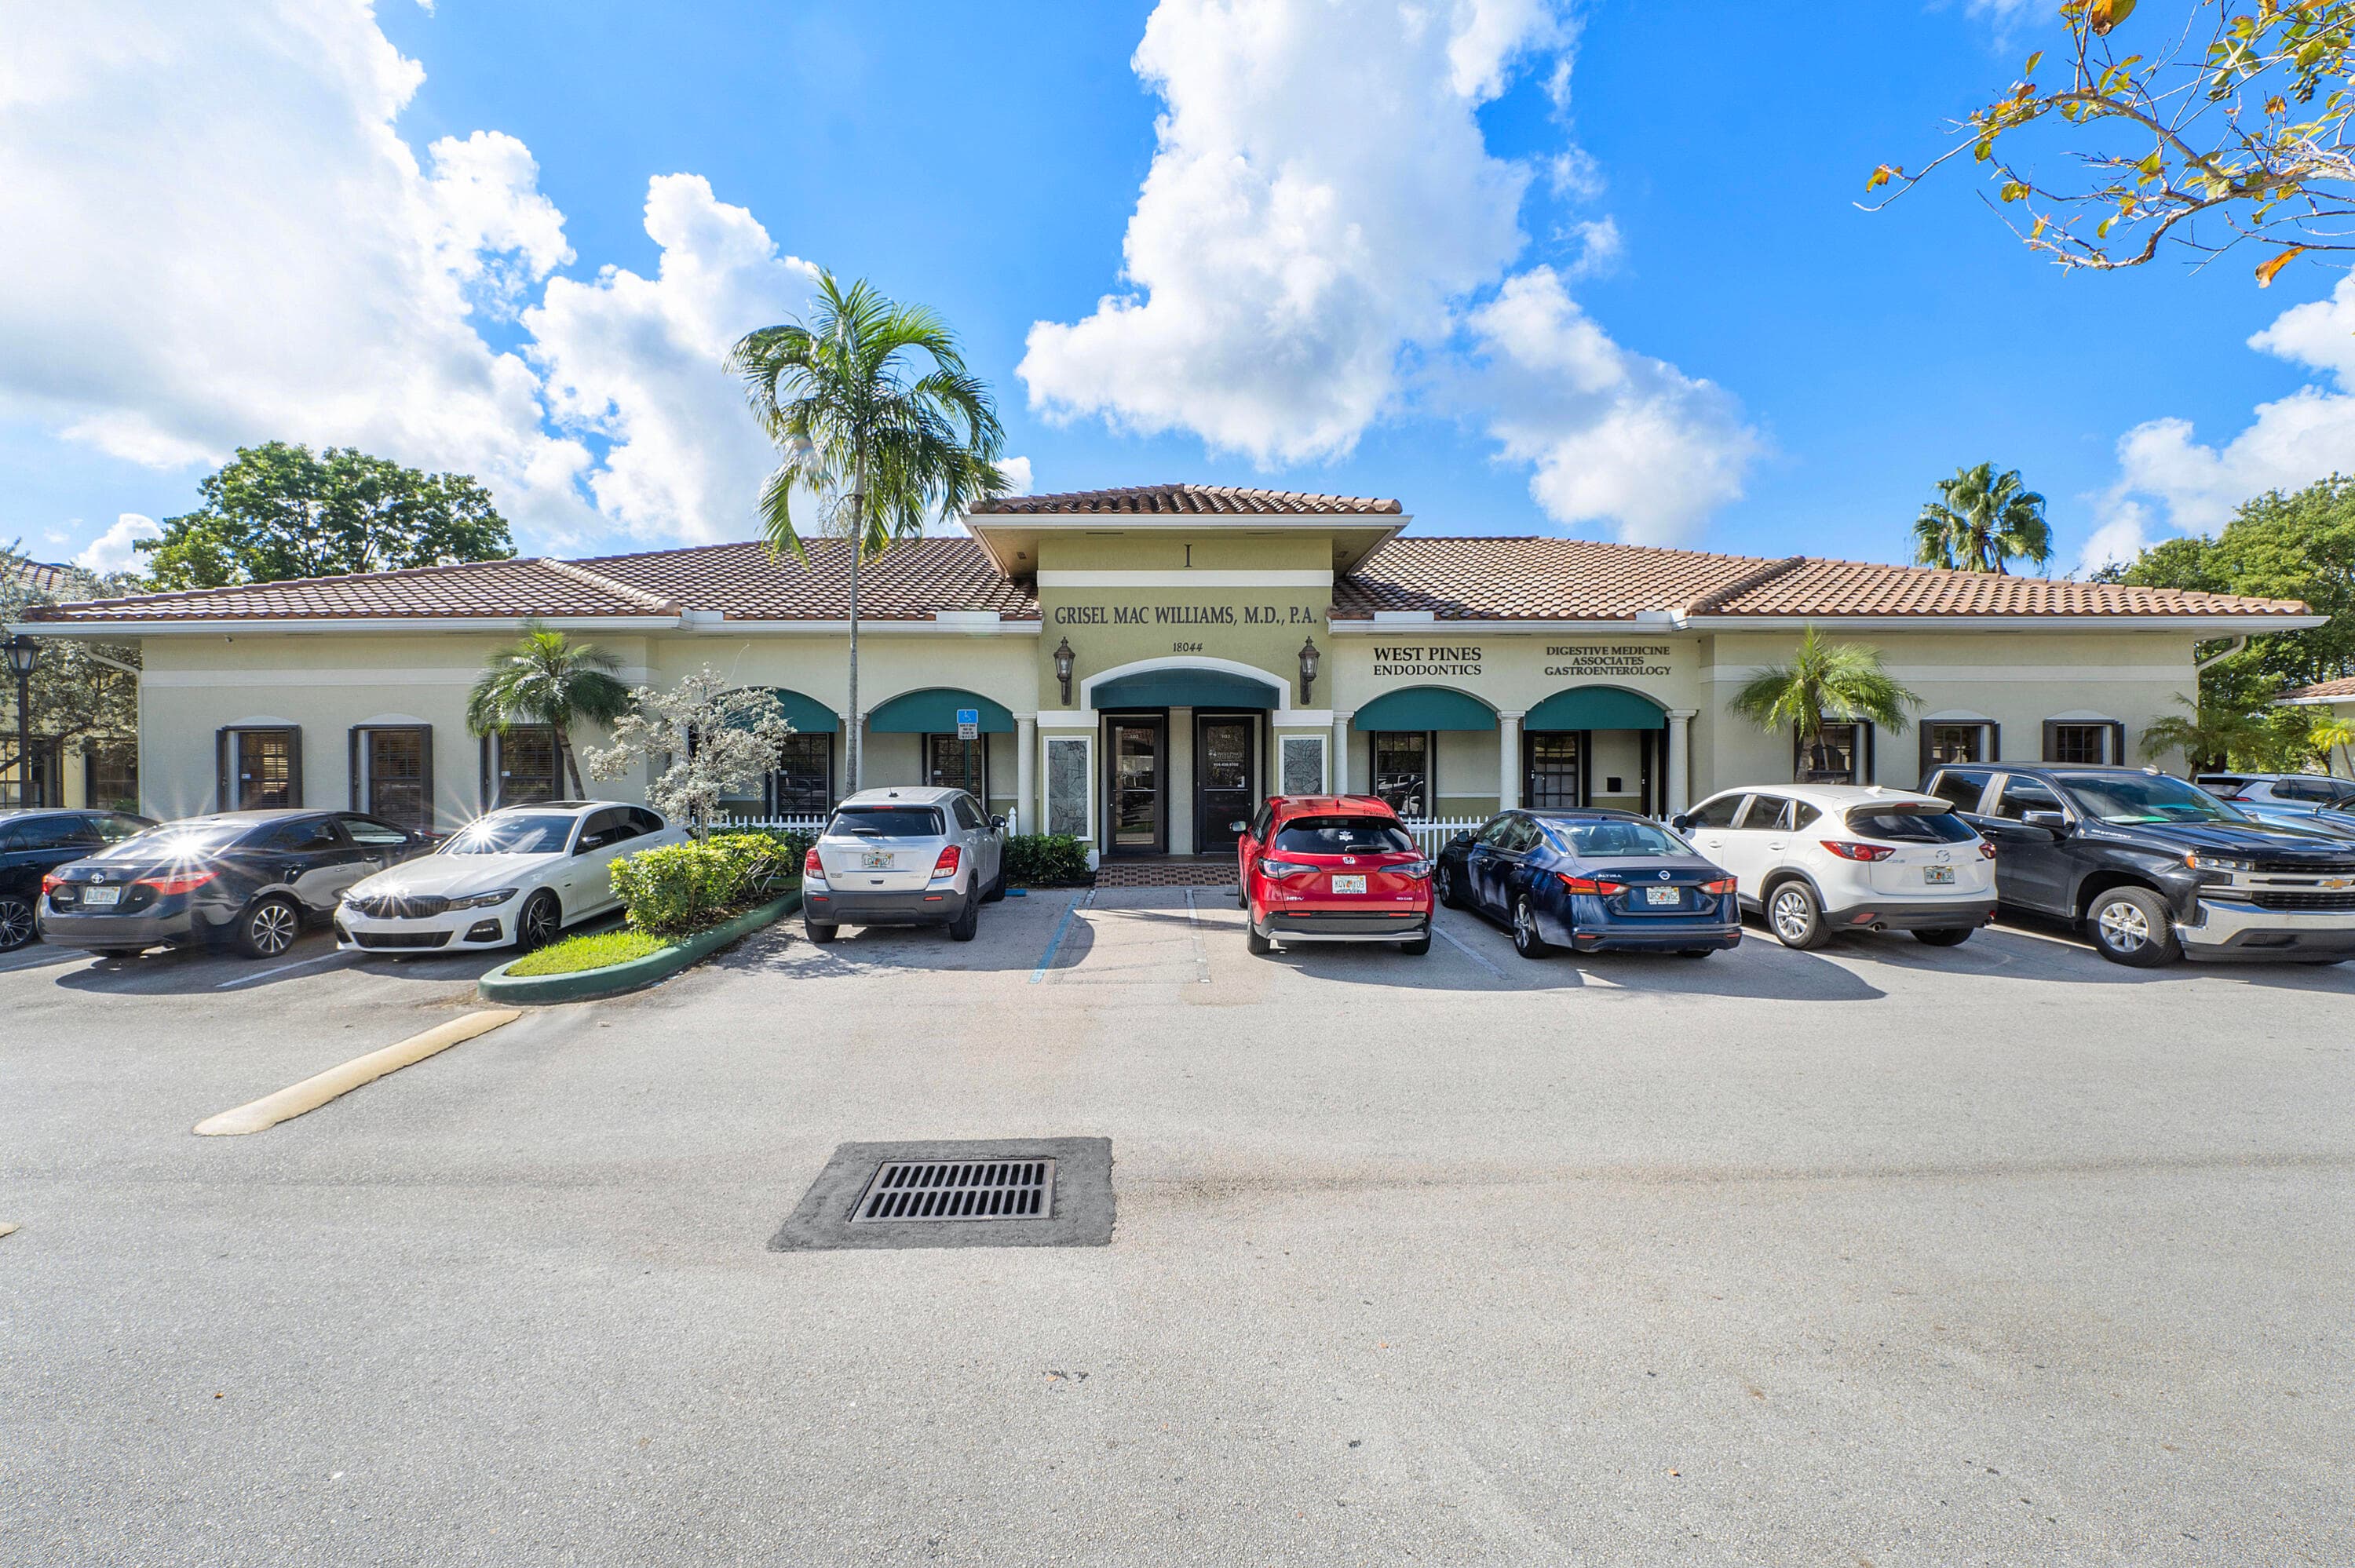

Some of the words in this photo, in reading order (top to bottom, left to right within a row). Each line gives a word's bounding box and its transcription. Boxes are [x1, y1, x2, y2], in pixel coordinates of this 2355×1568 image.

[1055, 607, 1108, 625] GRISEL
[1113, 607, 1149, 625] MAC
[1155, 607, 1238, 626] WILLIAMS,
[1244, 607, 1285, 626] M.D.,
[1289, 607, 1317, 625] P.A.
[1173, 642, 1203, 652] 18044
[1546, 647, 1608, 656] DIGESTIVE
[1611, 647, 1670, 656] MEDICINE
[1374, 647, 1424, 662] WEST
[1428, 647, 1482, 662] PINES
[1572, 656, 1645, 665] ASSOCIATES
[1373, 665, 1482, 676] ENDODONTICS
[1544, 666, 1671, 676] GASTROENTEROLOGY
